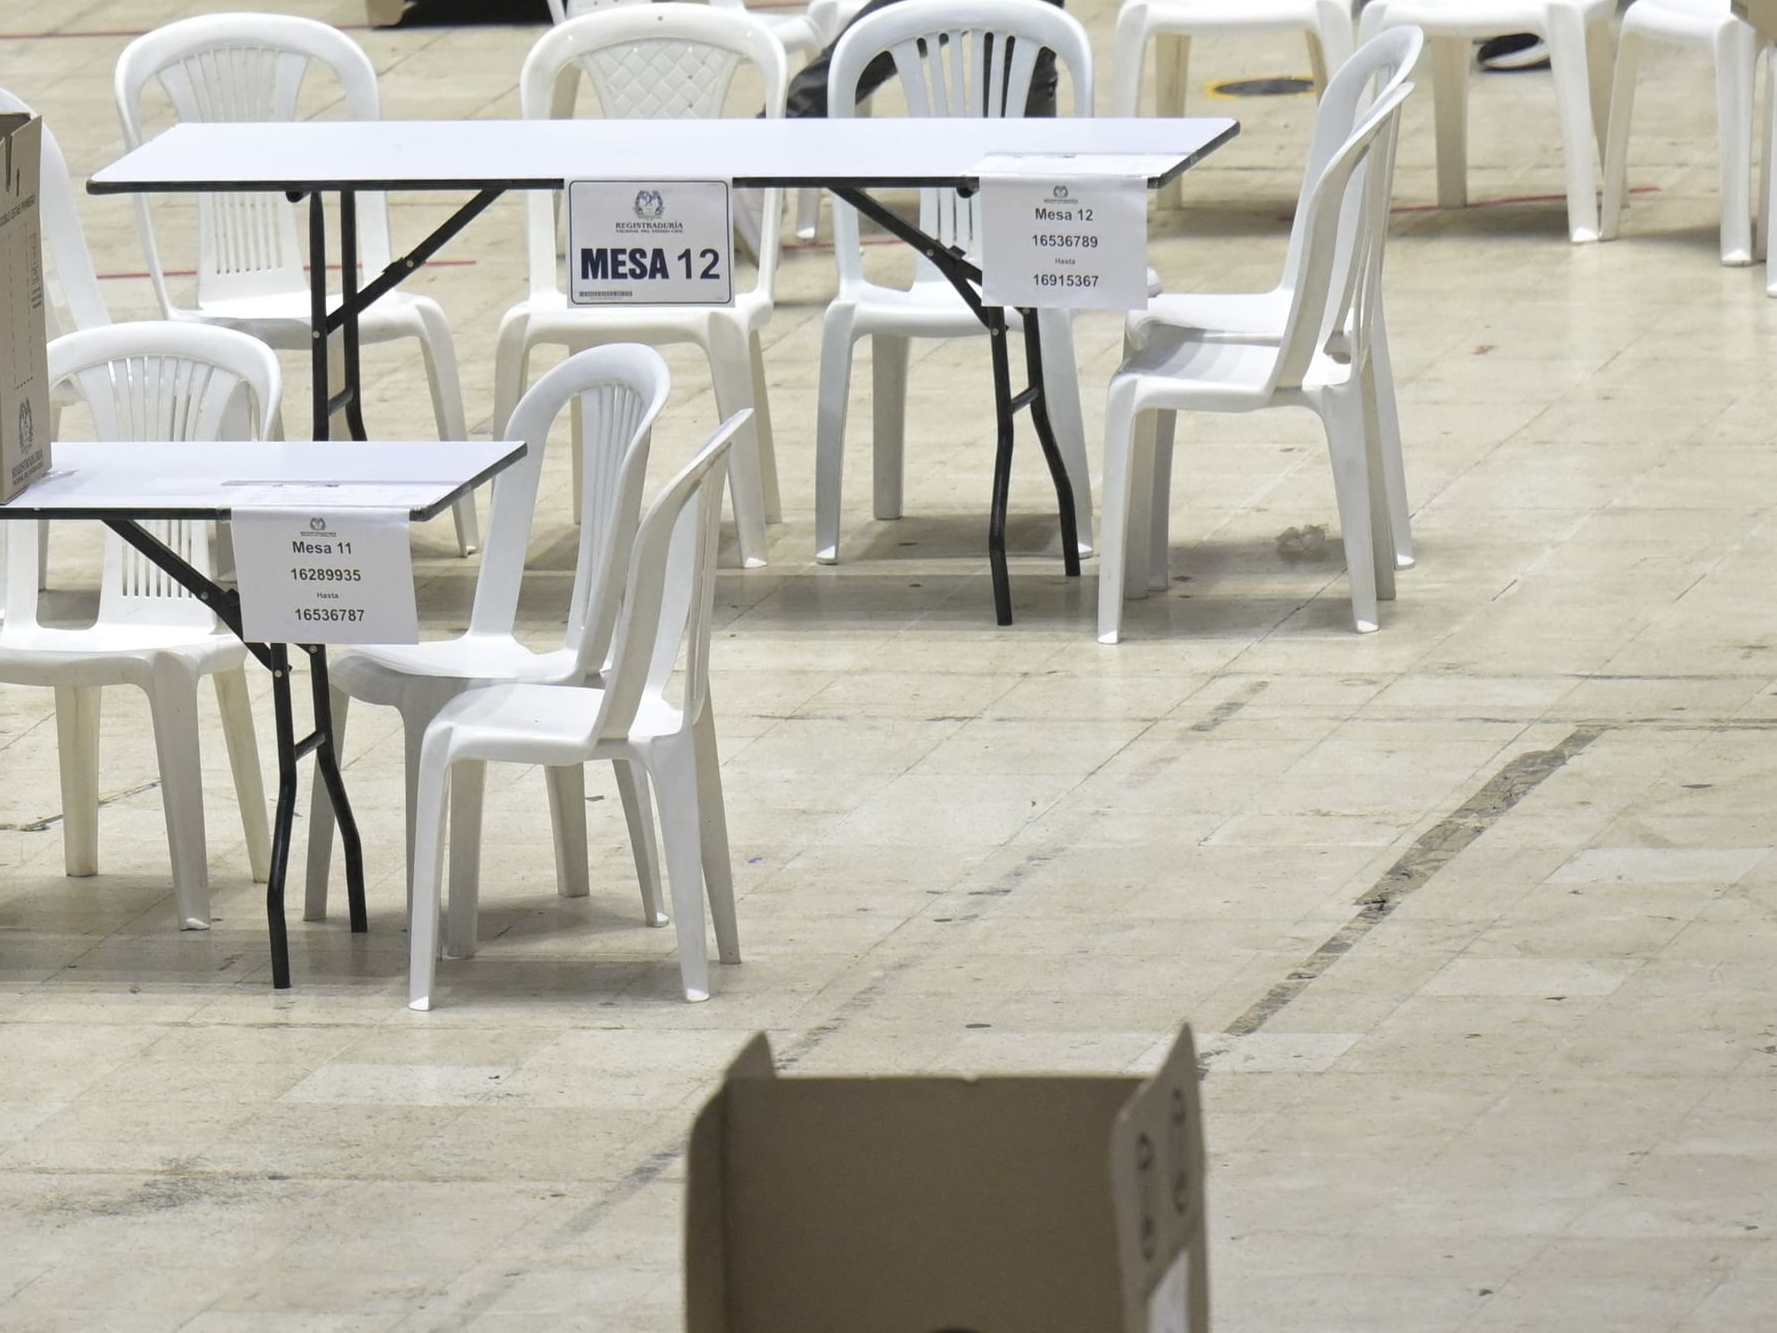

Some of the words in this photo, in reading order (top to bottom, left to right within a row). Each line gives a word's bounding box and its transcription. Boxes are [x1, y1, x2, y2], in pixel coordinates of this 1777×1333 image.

[1034, 208, 1072, 221] Mesa
[1077, 209, 1094, 221] 12
[1032, 234, 1099, 248] 16536789
[580, 247, 670, 281] MESA
[677, 247, 721, 280] 12
[1054, 257, 1076, 266] Hasta
[1033, 274, 1099, 288] 16915367
[292, 540, 332, 554] Mesa
[337, 542, 352, 555] 11
[290, 568, 362, 582] 16289935
[316, 591, 340, 600] Hasta
[294, 608, 365, 622] 16536787
